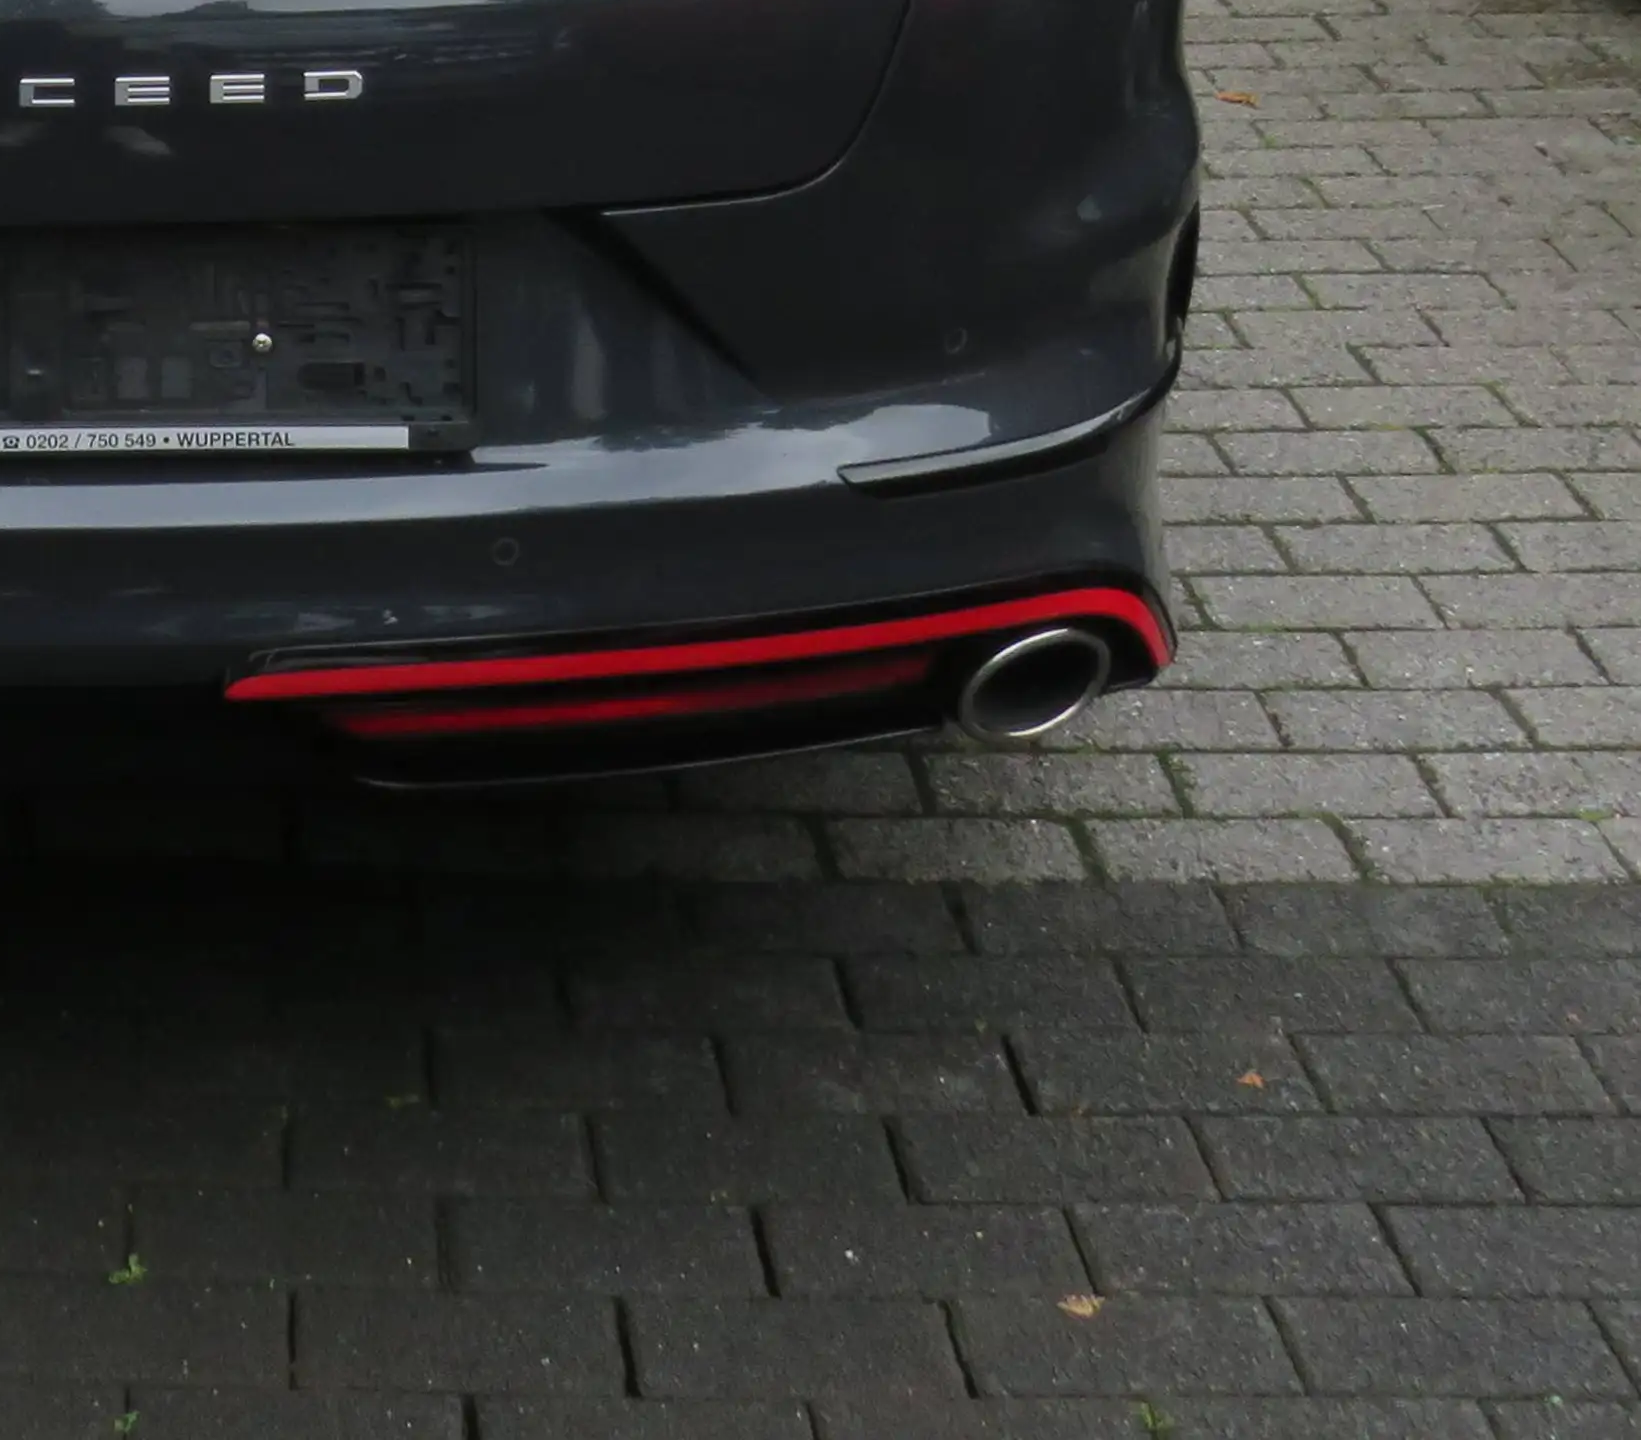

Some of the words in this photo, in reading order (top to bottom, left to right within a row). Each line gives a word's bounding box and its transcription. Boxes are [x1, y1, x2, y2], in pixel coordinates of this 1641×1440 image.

[26, 433, 69, 449] 0202
[87, 433, 120, 449] 750
[125, 433, 157, 448] 549
[177, 431, 295, 448] WUPPERTAL
